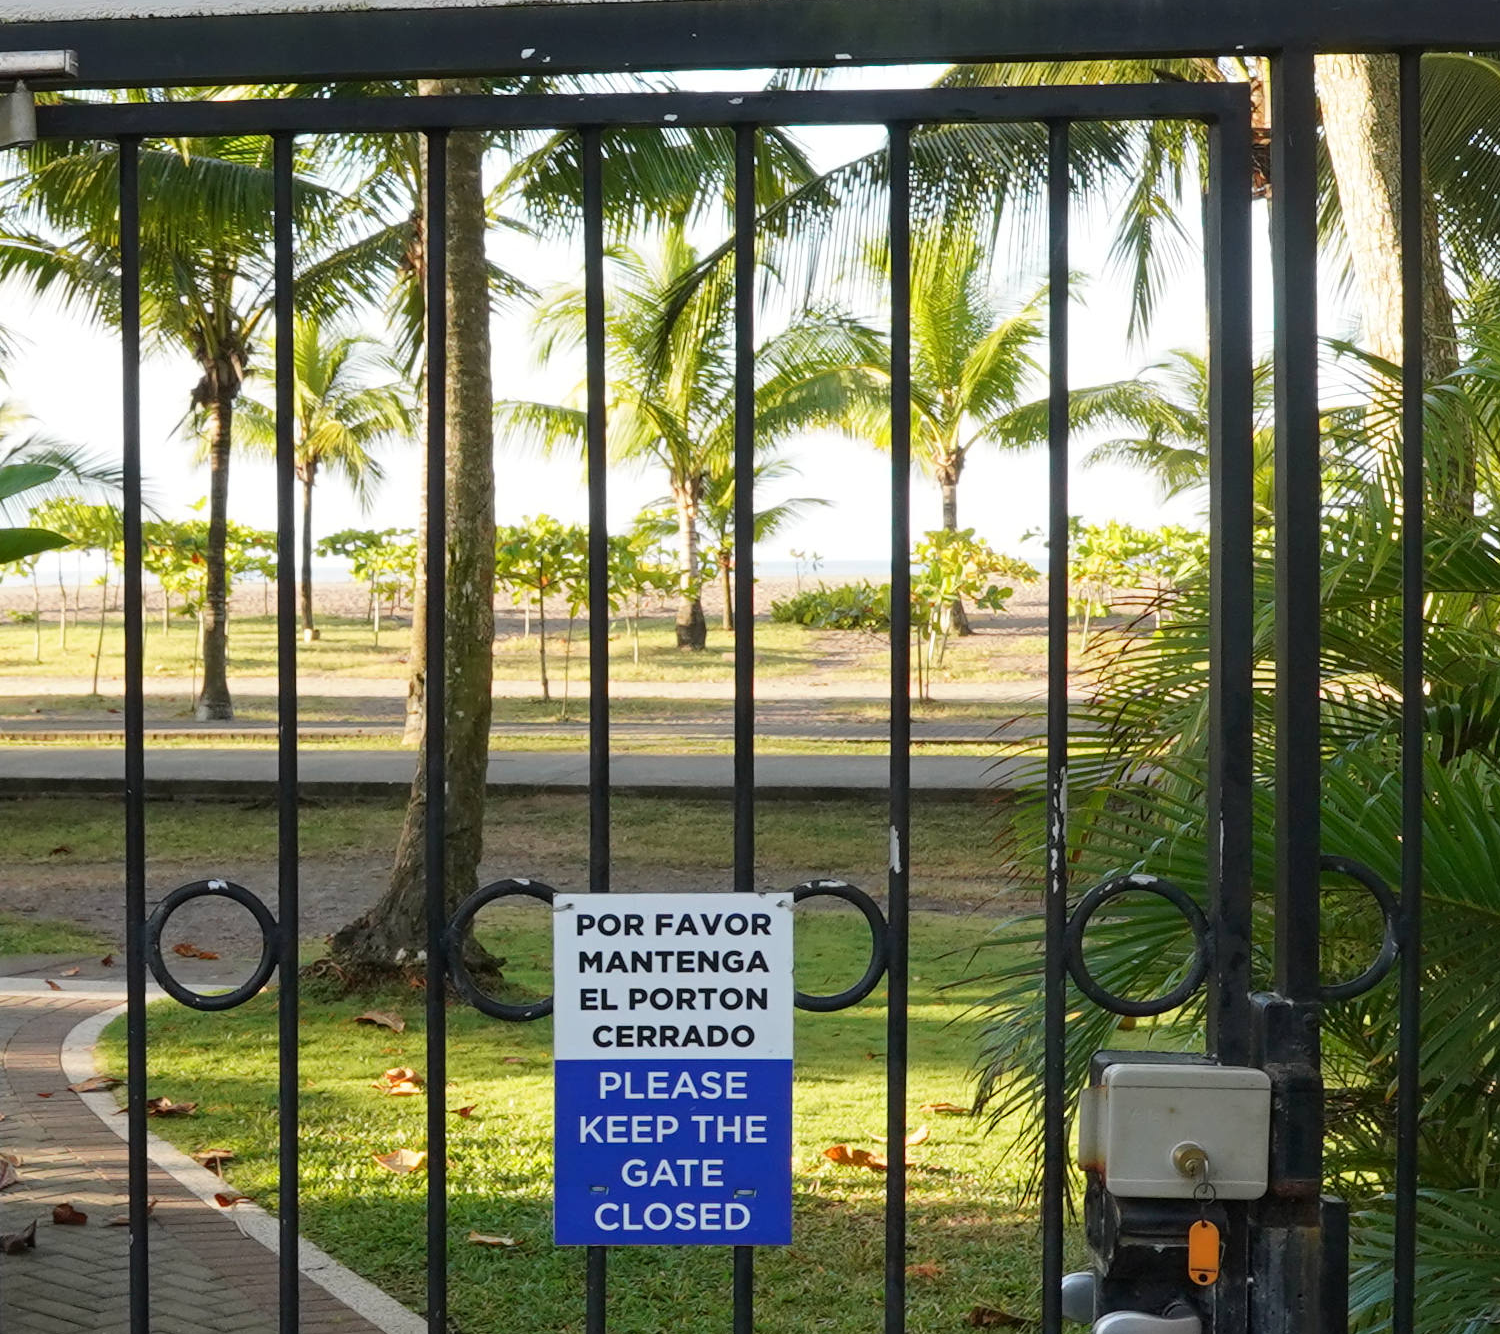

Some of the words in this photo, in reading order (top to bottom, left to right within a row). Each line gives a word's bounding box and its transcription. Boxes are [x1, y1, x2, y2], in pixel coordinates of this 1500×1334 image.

[576, 913, 644, 937] POR
[655, 912, 772, 936] FAVOR
[578, 950, 770, 974] MANTENGA
[580, 988, 619, 1011] EL
[628, 987, 768, 1011] PORTON
[592, 1024, 755, 1048] CERRADO
[599, 1071, 748, 1100] PLEASE
[579, 1115, 679, 1144] KEEP
[690, 1115, 768, 1144] THE
[621, 1158, 724, 1188] GATE
[594, 1202, 751, 1231] CLOSED
